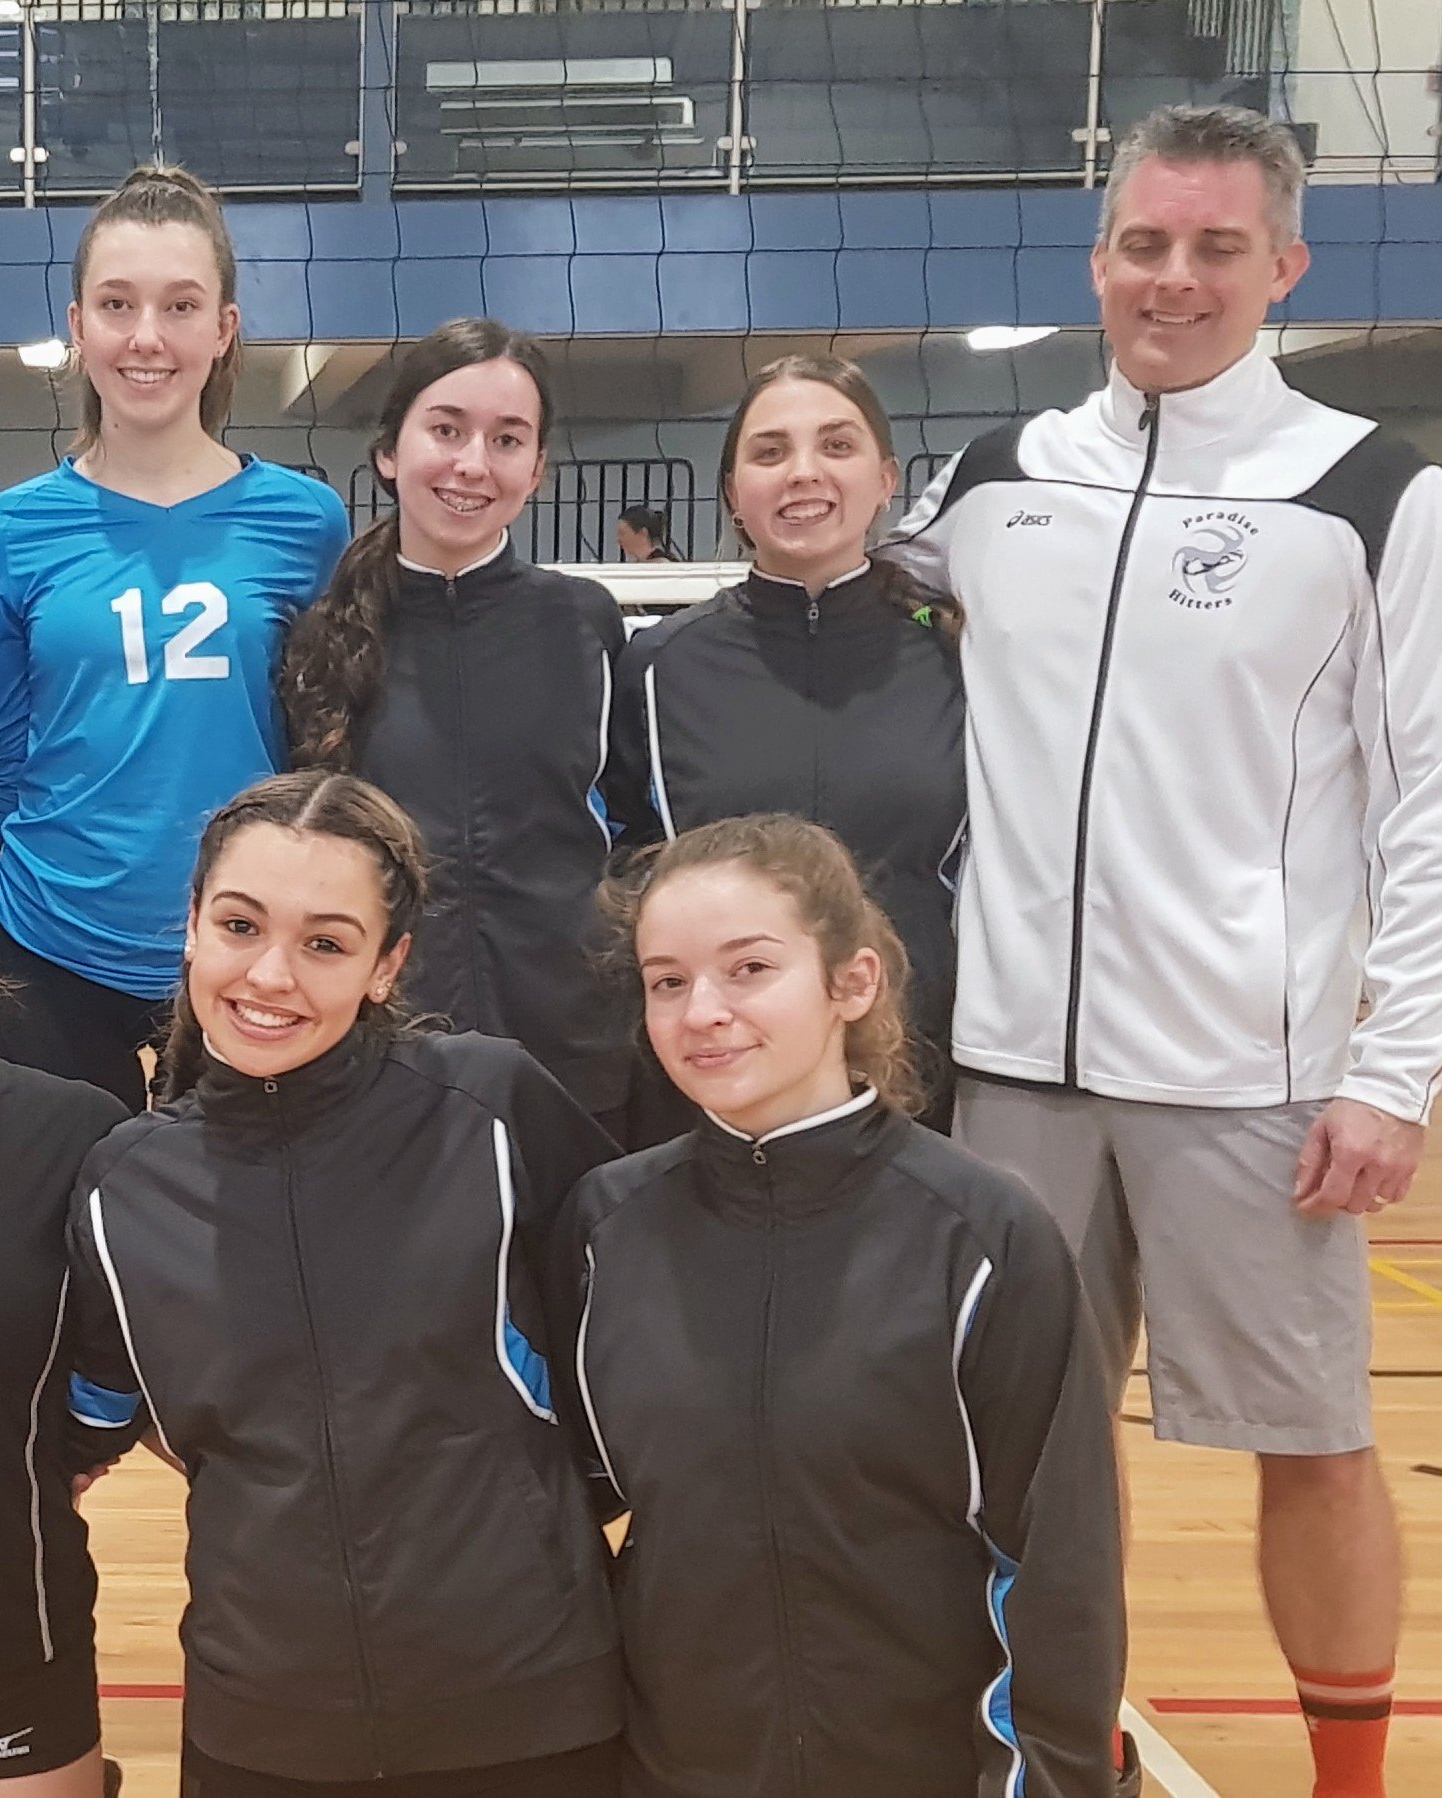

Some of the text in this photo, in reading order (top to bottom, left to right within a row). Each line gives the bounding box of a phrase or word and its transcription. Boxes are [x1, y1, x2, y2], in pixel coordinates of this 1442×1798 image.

[1182, 510, 1260, 536] Paradise
[1168, 588, 1233, 610] Hitters
[110, 581, 230, 685] 12
